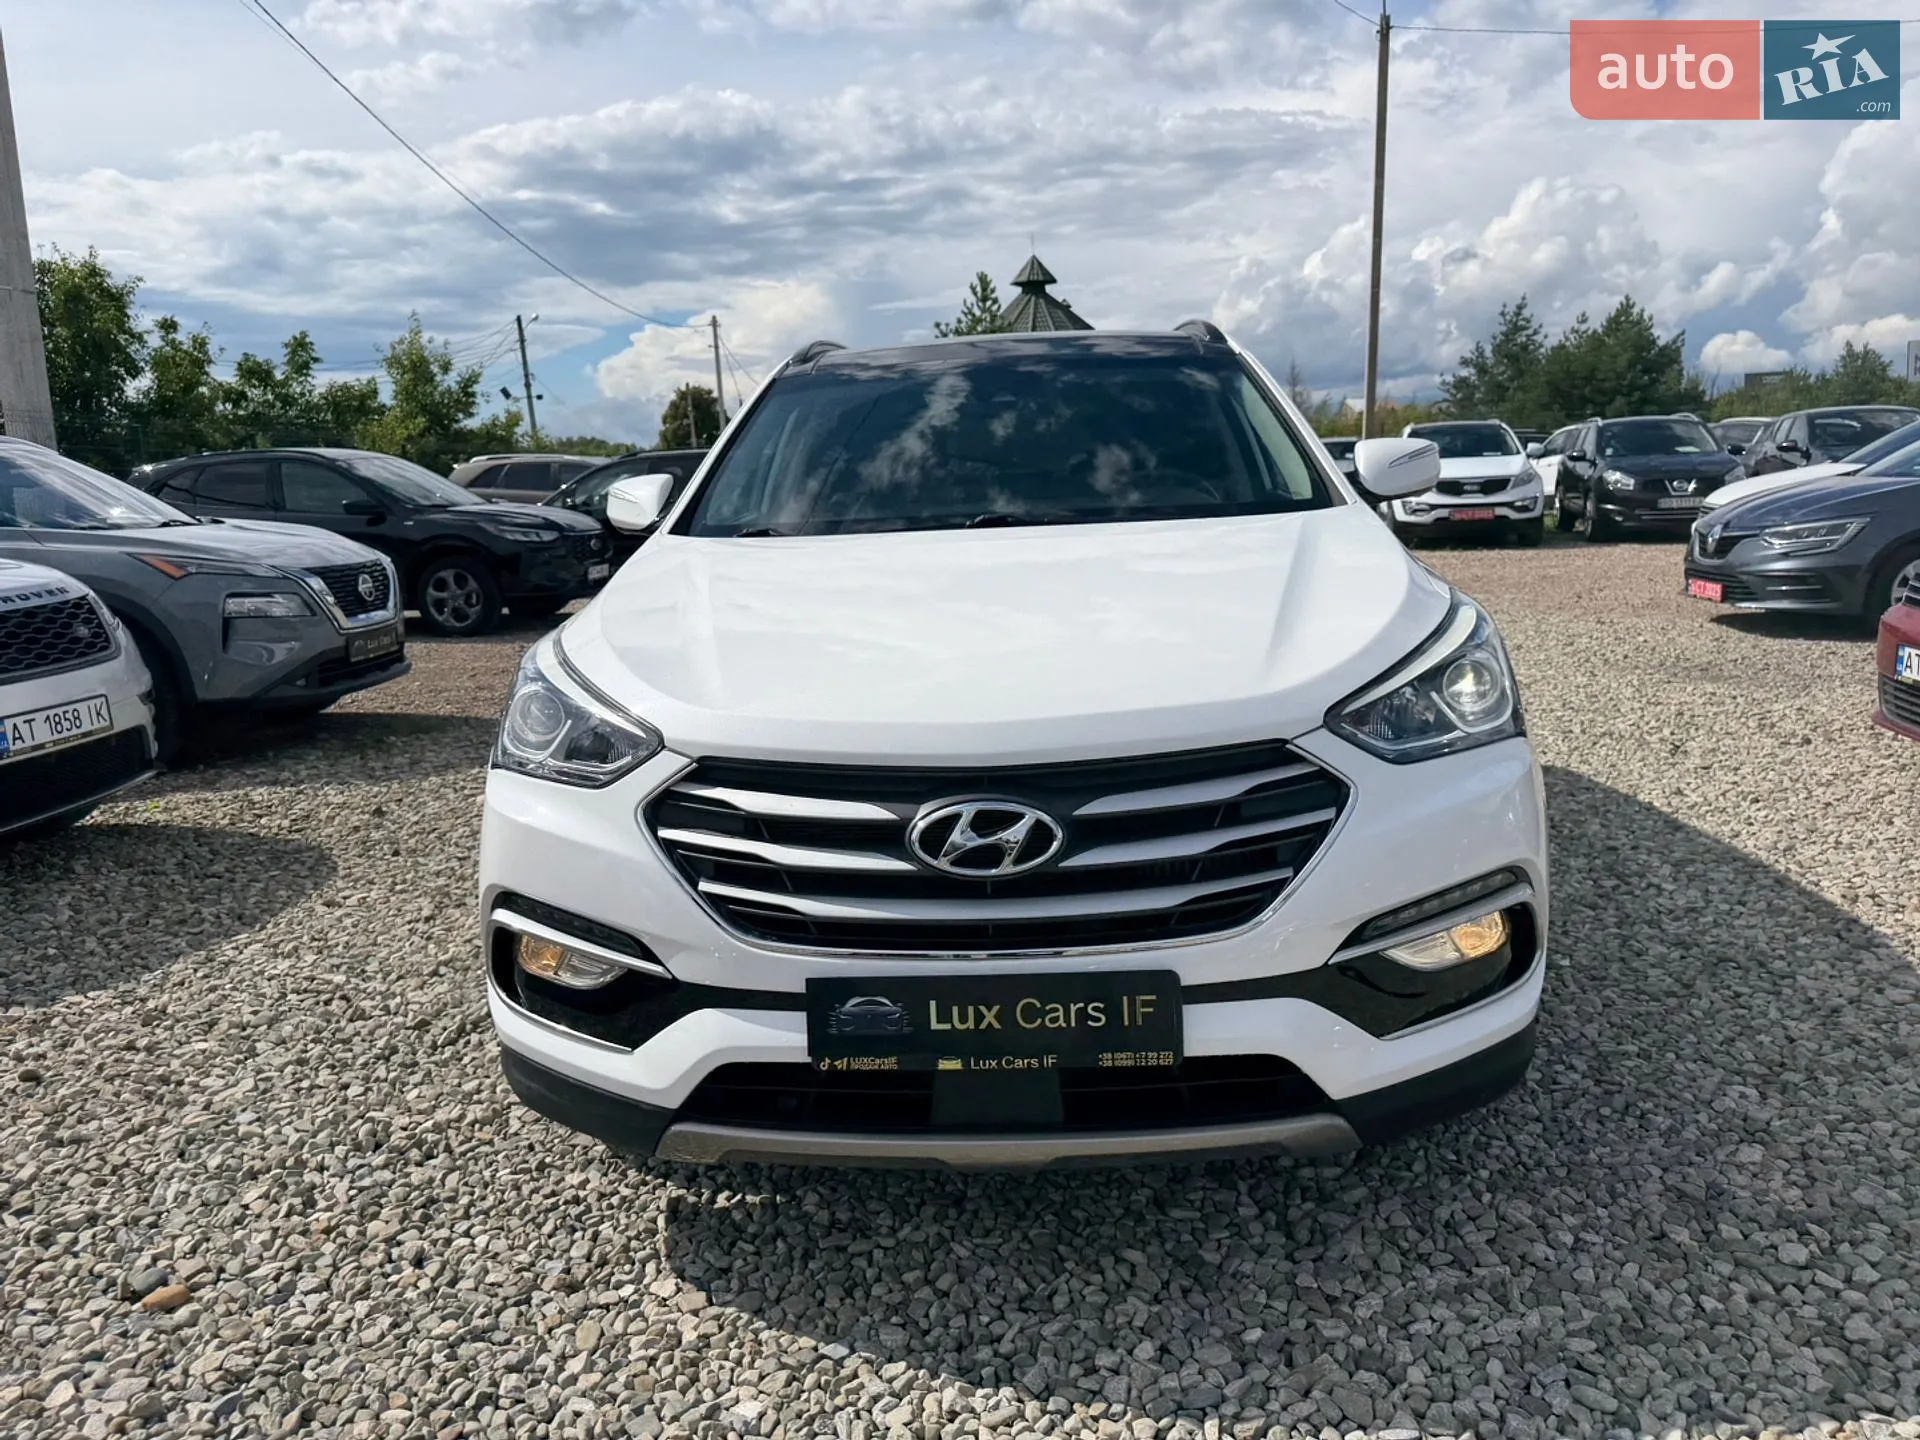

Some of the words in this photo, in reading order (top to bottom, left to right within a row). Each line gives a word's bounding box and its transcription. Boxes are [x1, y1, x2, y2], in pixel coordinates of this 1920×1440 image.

[12, 717, 36, 746] AT
[44, 708, 83, 737] 1858
[87, 700, 108, 727] IK
[929, 999, 1002, 1031] Lux
[1016, 996, 1106, 1029] Cars
[1122, 995, 1158, 1026] IF
[970, 1056, 998, 1070] Lux
[1002, 1055, 1040, 1069] Cars
[1043, 1054, 1058, 1068] IF
